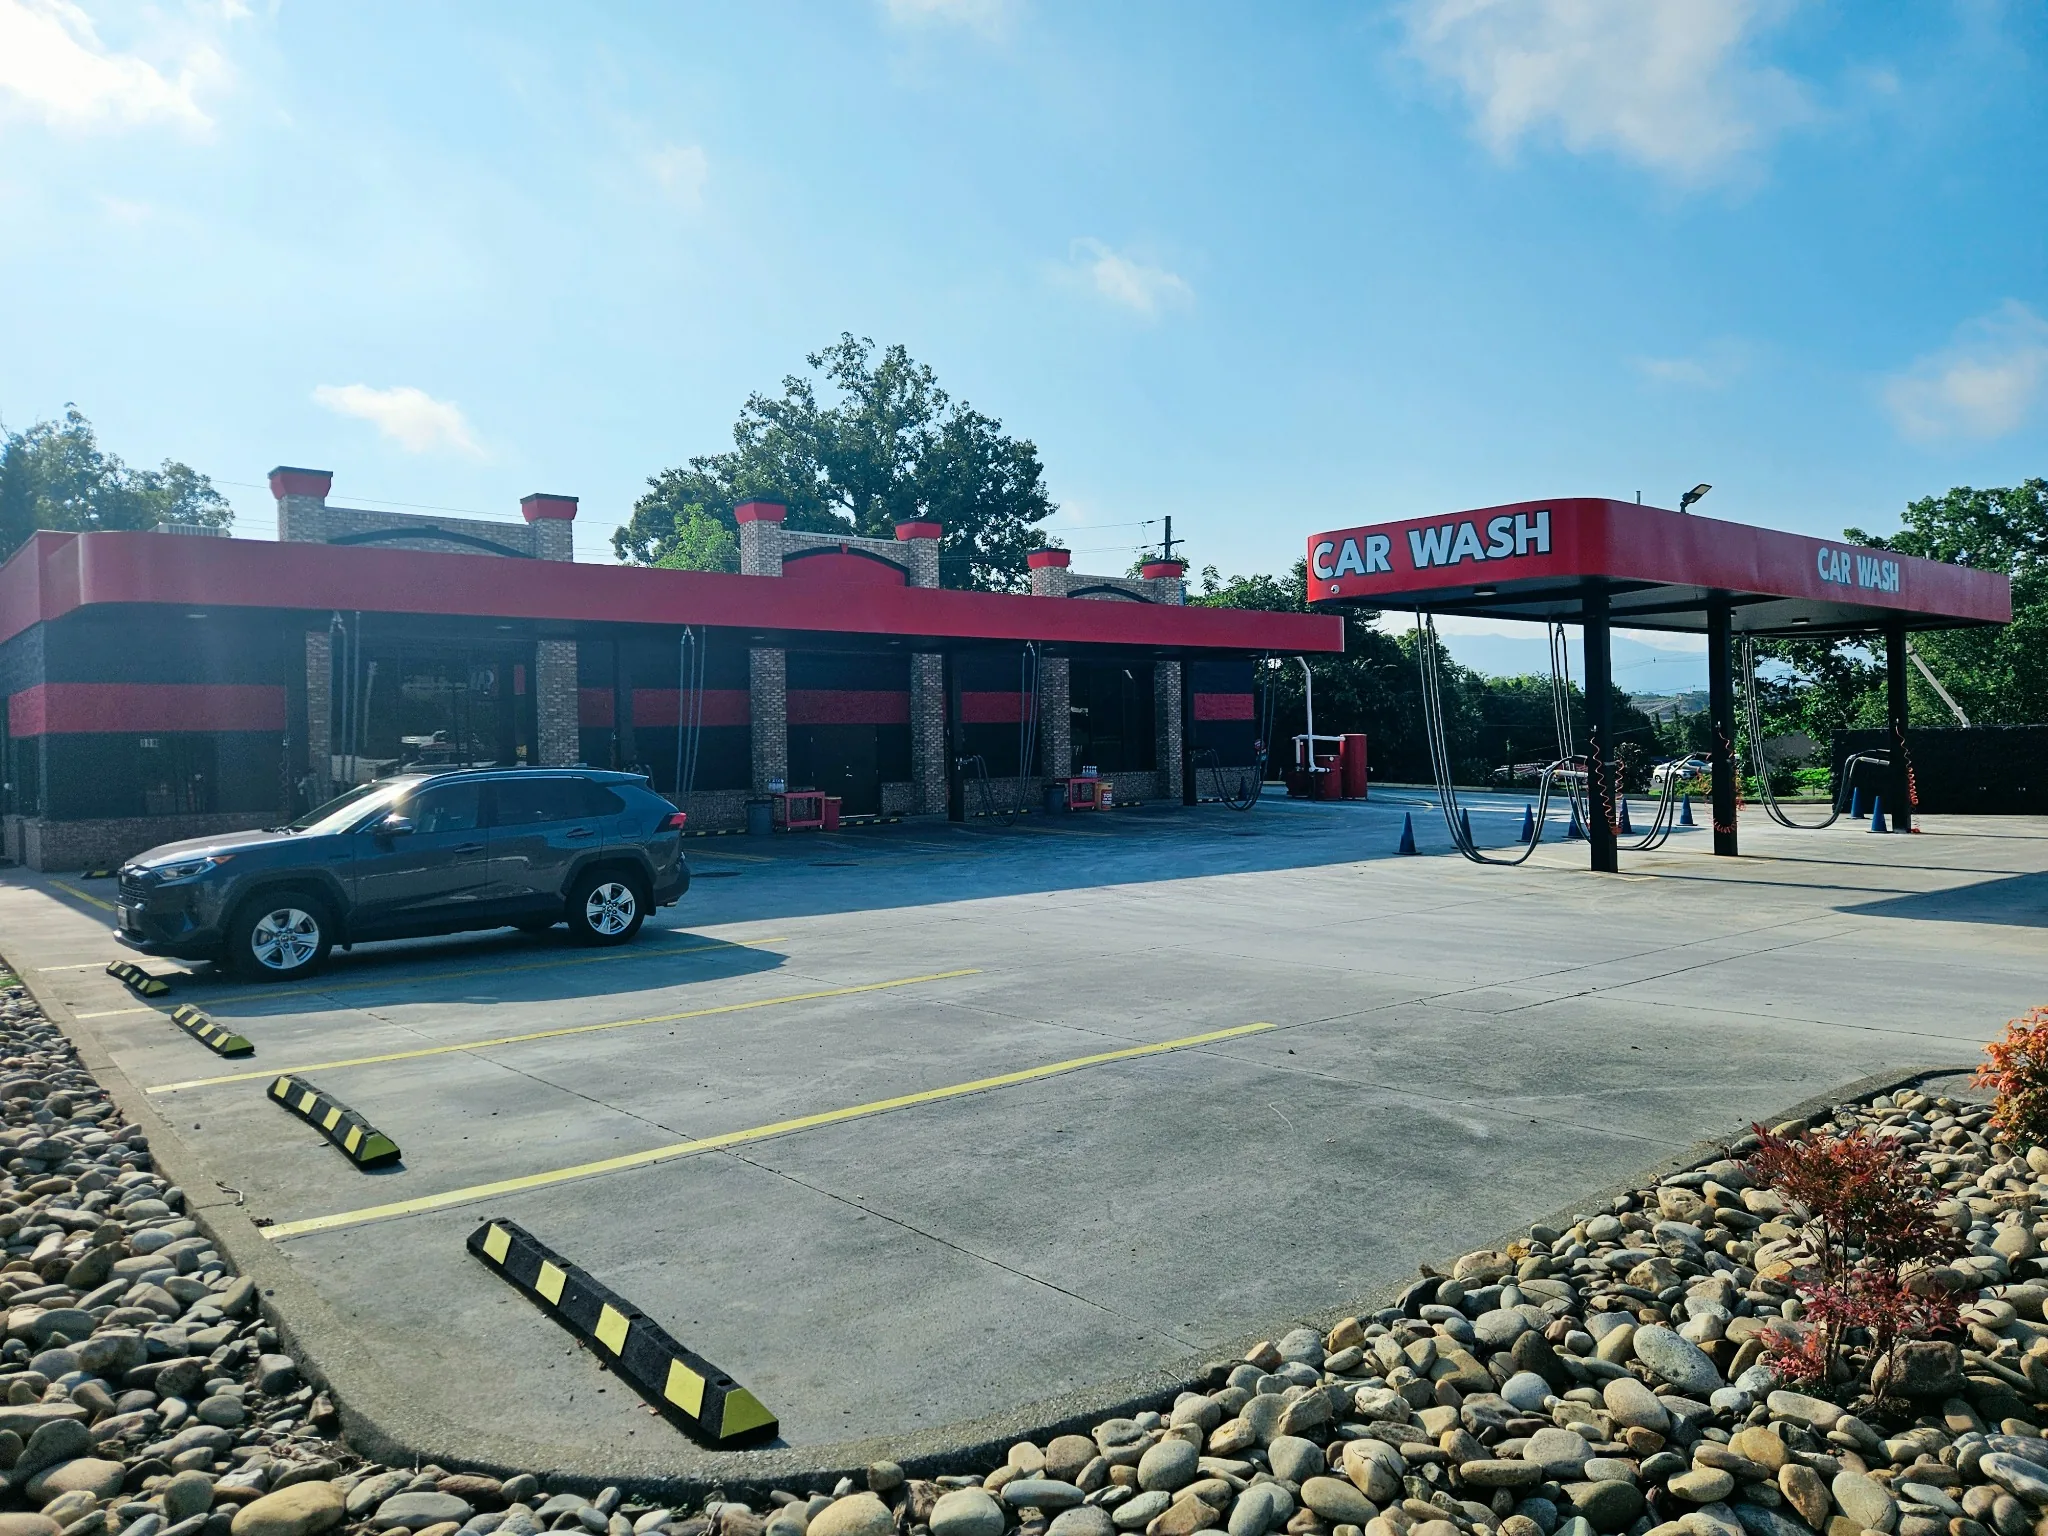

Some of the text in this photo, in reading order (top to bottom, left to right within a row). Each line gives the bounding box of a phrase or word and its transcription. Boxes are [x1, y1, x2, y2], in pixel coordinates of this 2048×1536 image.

[1312, 510, 1550, 580] CAR WASH
[1817, 547, 1900, 592] CAR WASH
